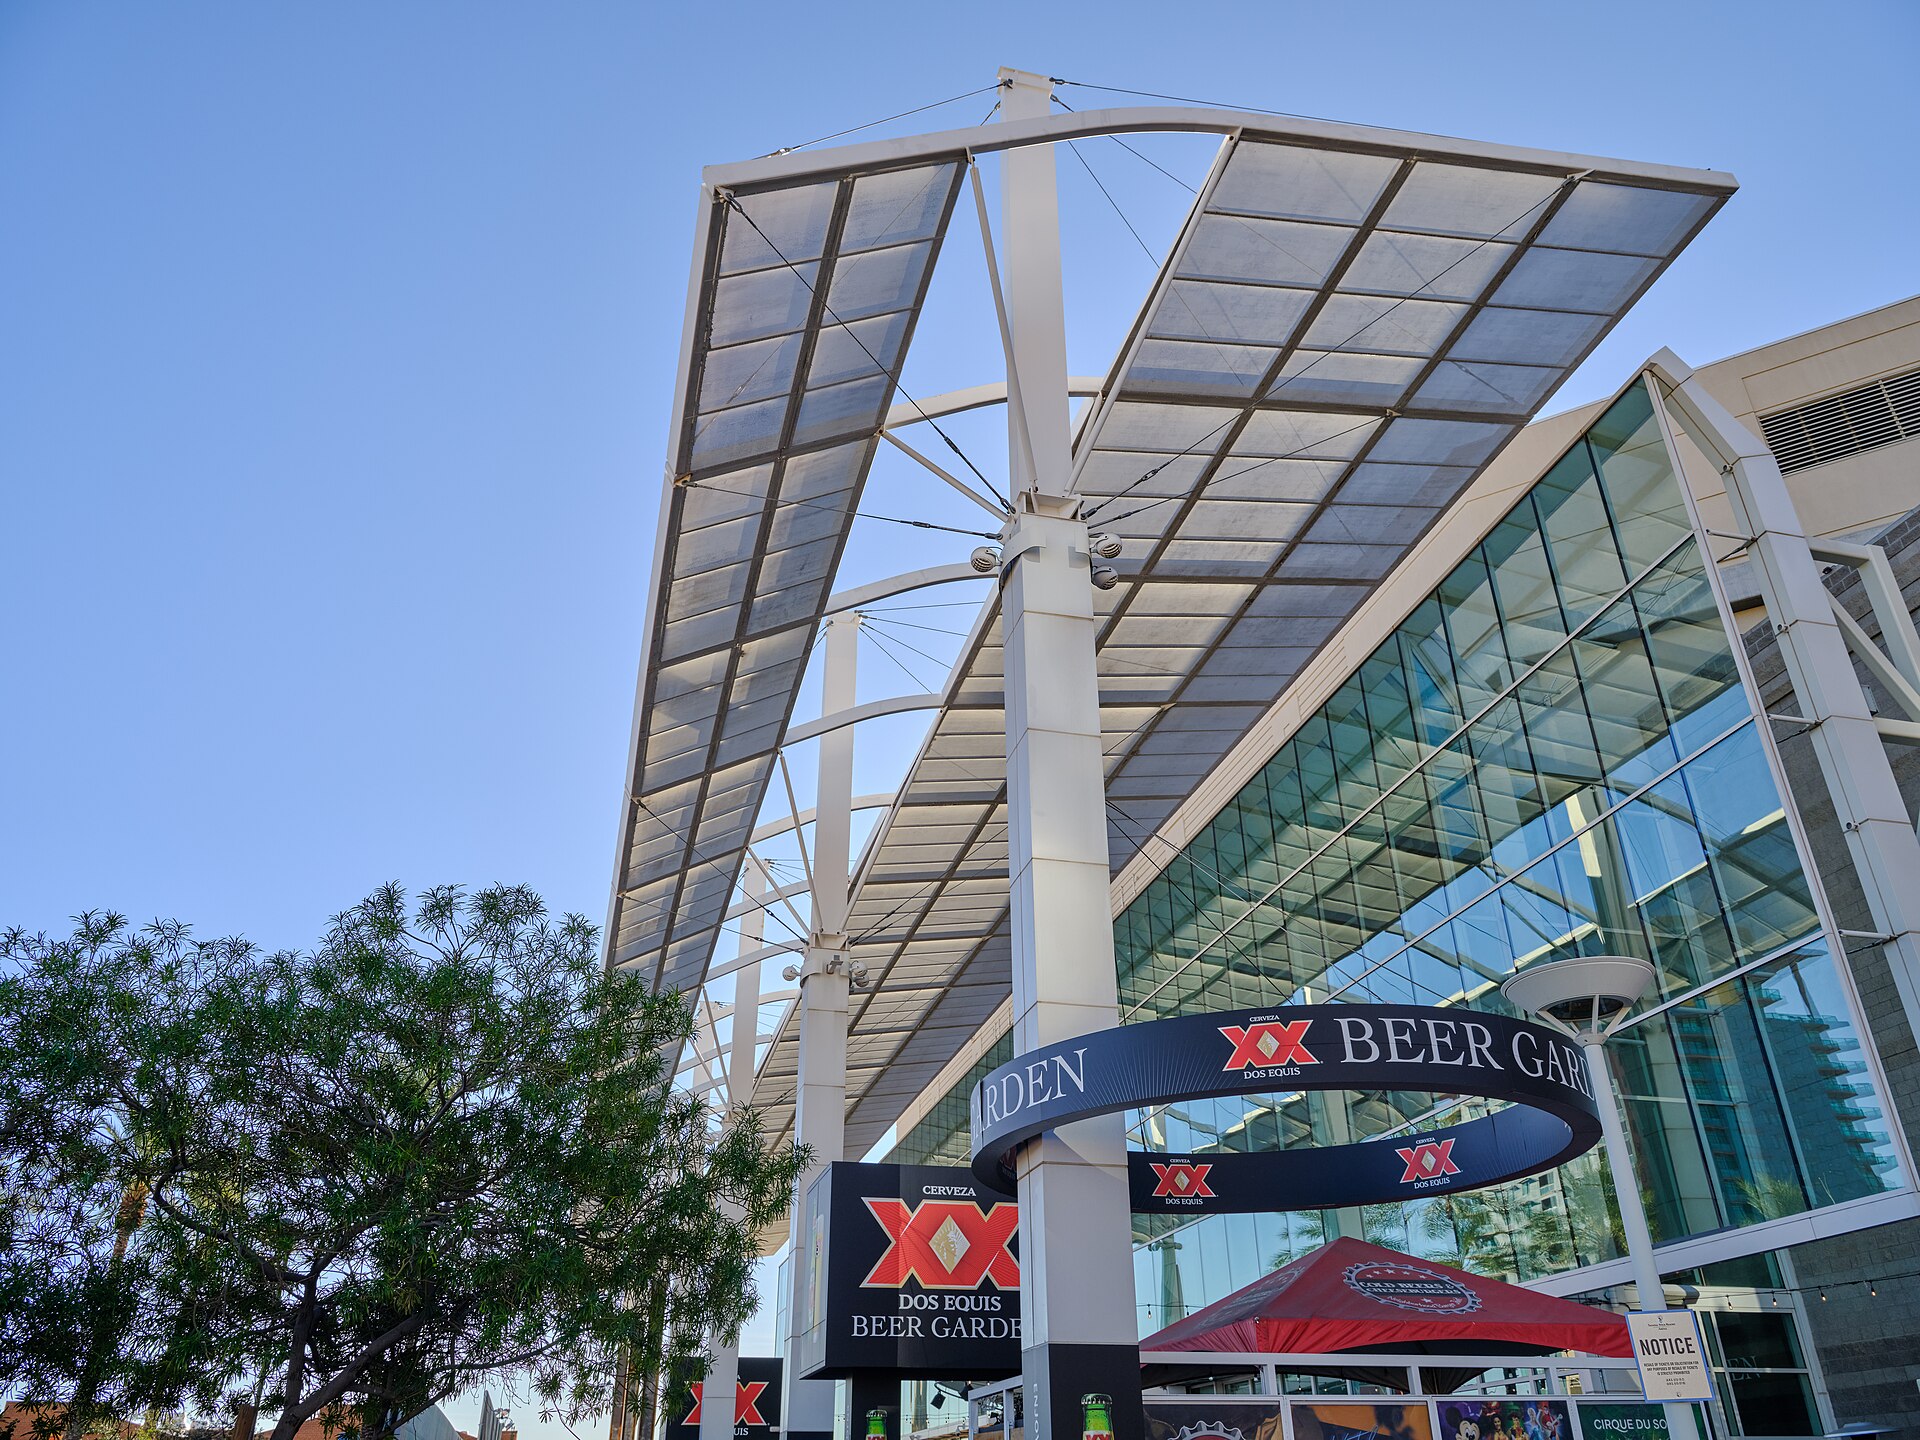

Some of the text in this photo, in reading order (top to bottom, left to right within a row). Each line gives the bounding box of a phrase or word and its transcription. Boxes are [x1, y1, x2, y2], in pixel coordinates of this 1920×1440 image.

[1334, 1017, 1505, 1070] BEER
[1244, 1067, 1301, 1079] DOS EQUIS
[1416, 1137, 1436, 1145] CERVEZA
[1430, 1177, 1450, 1187] EQUIS
[922, 1185, 976, 1197] CERVEZA
[898, 1294, 1002, 1312] DOS EQUIS
[851, 1315, 925, 1338] BEER
[1639, 1337, 1696, 1356] NOTICE
[733, 1427, 749, 1436] UIS
[1593, 1419, 1634, 1433] CIRQUE
[1636, 1419, 1651, 1429] DU
